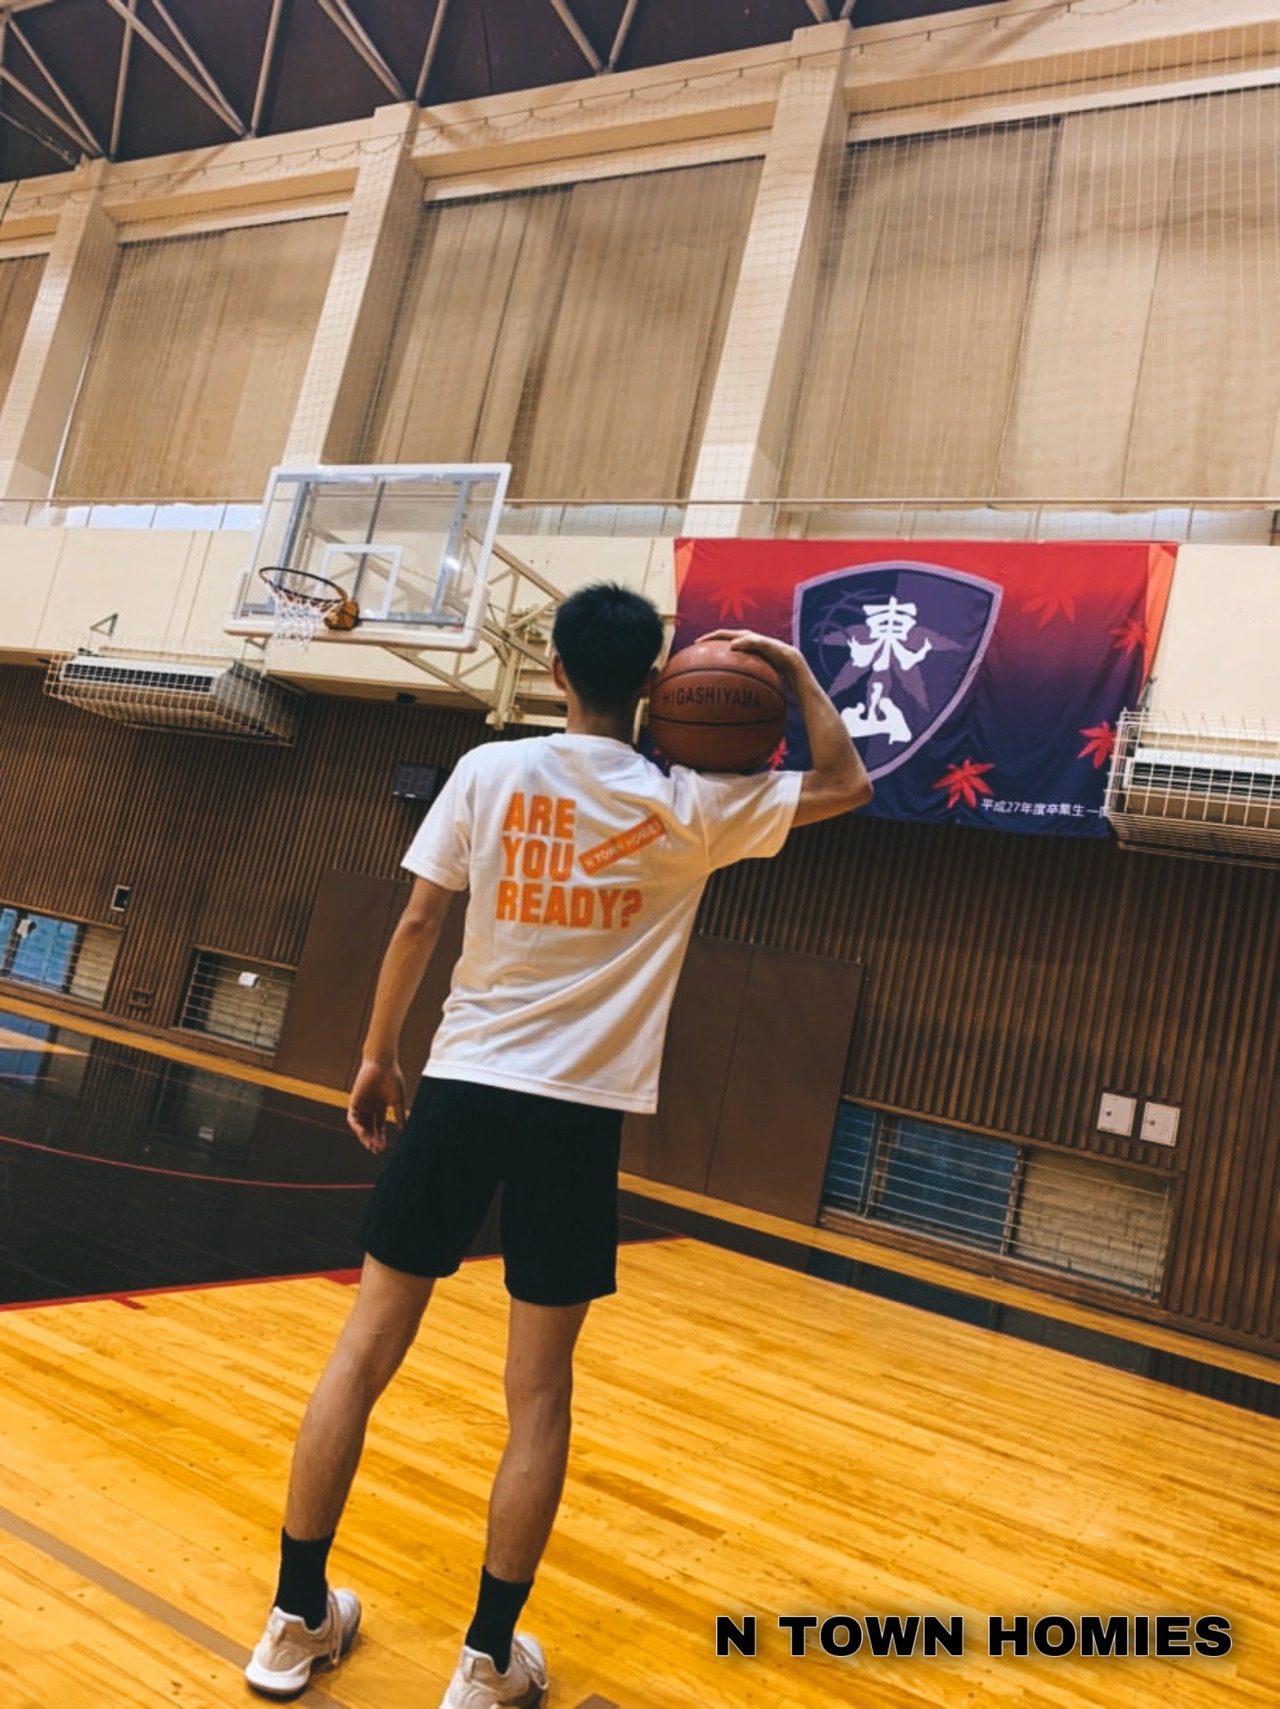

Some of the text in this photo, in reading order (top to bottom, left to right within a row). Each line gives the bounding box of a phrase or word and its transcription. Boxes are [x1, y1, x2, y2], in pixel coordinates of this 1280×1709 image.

[661, 681, 763, 707] HIGASHIYAMA
[840, 595, 932, 744] 東山
[502, 791, 577, 840] ARE
[501, 836, 575, 882] YOU
[495, 879, 643, 929] READY?
